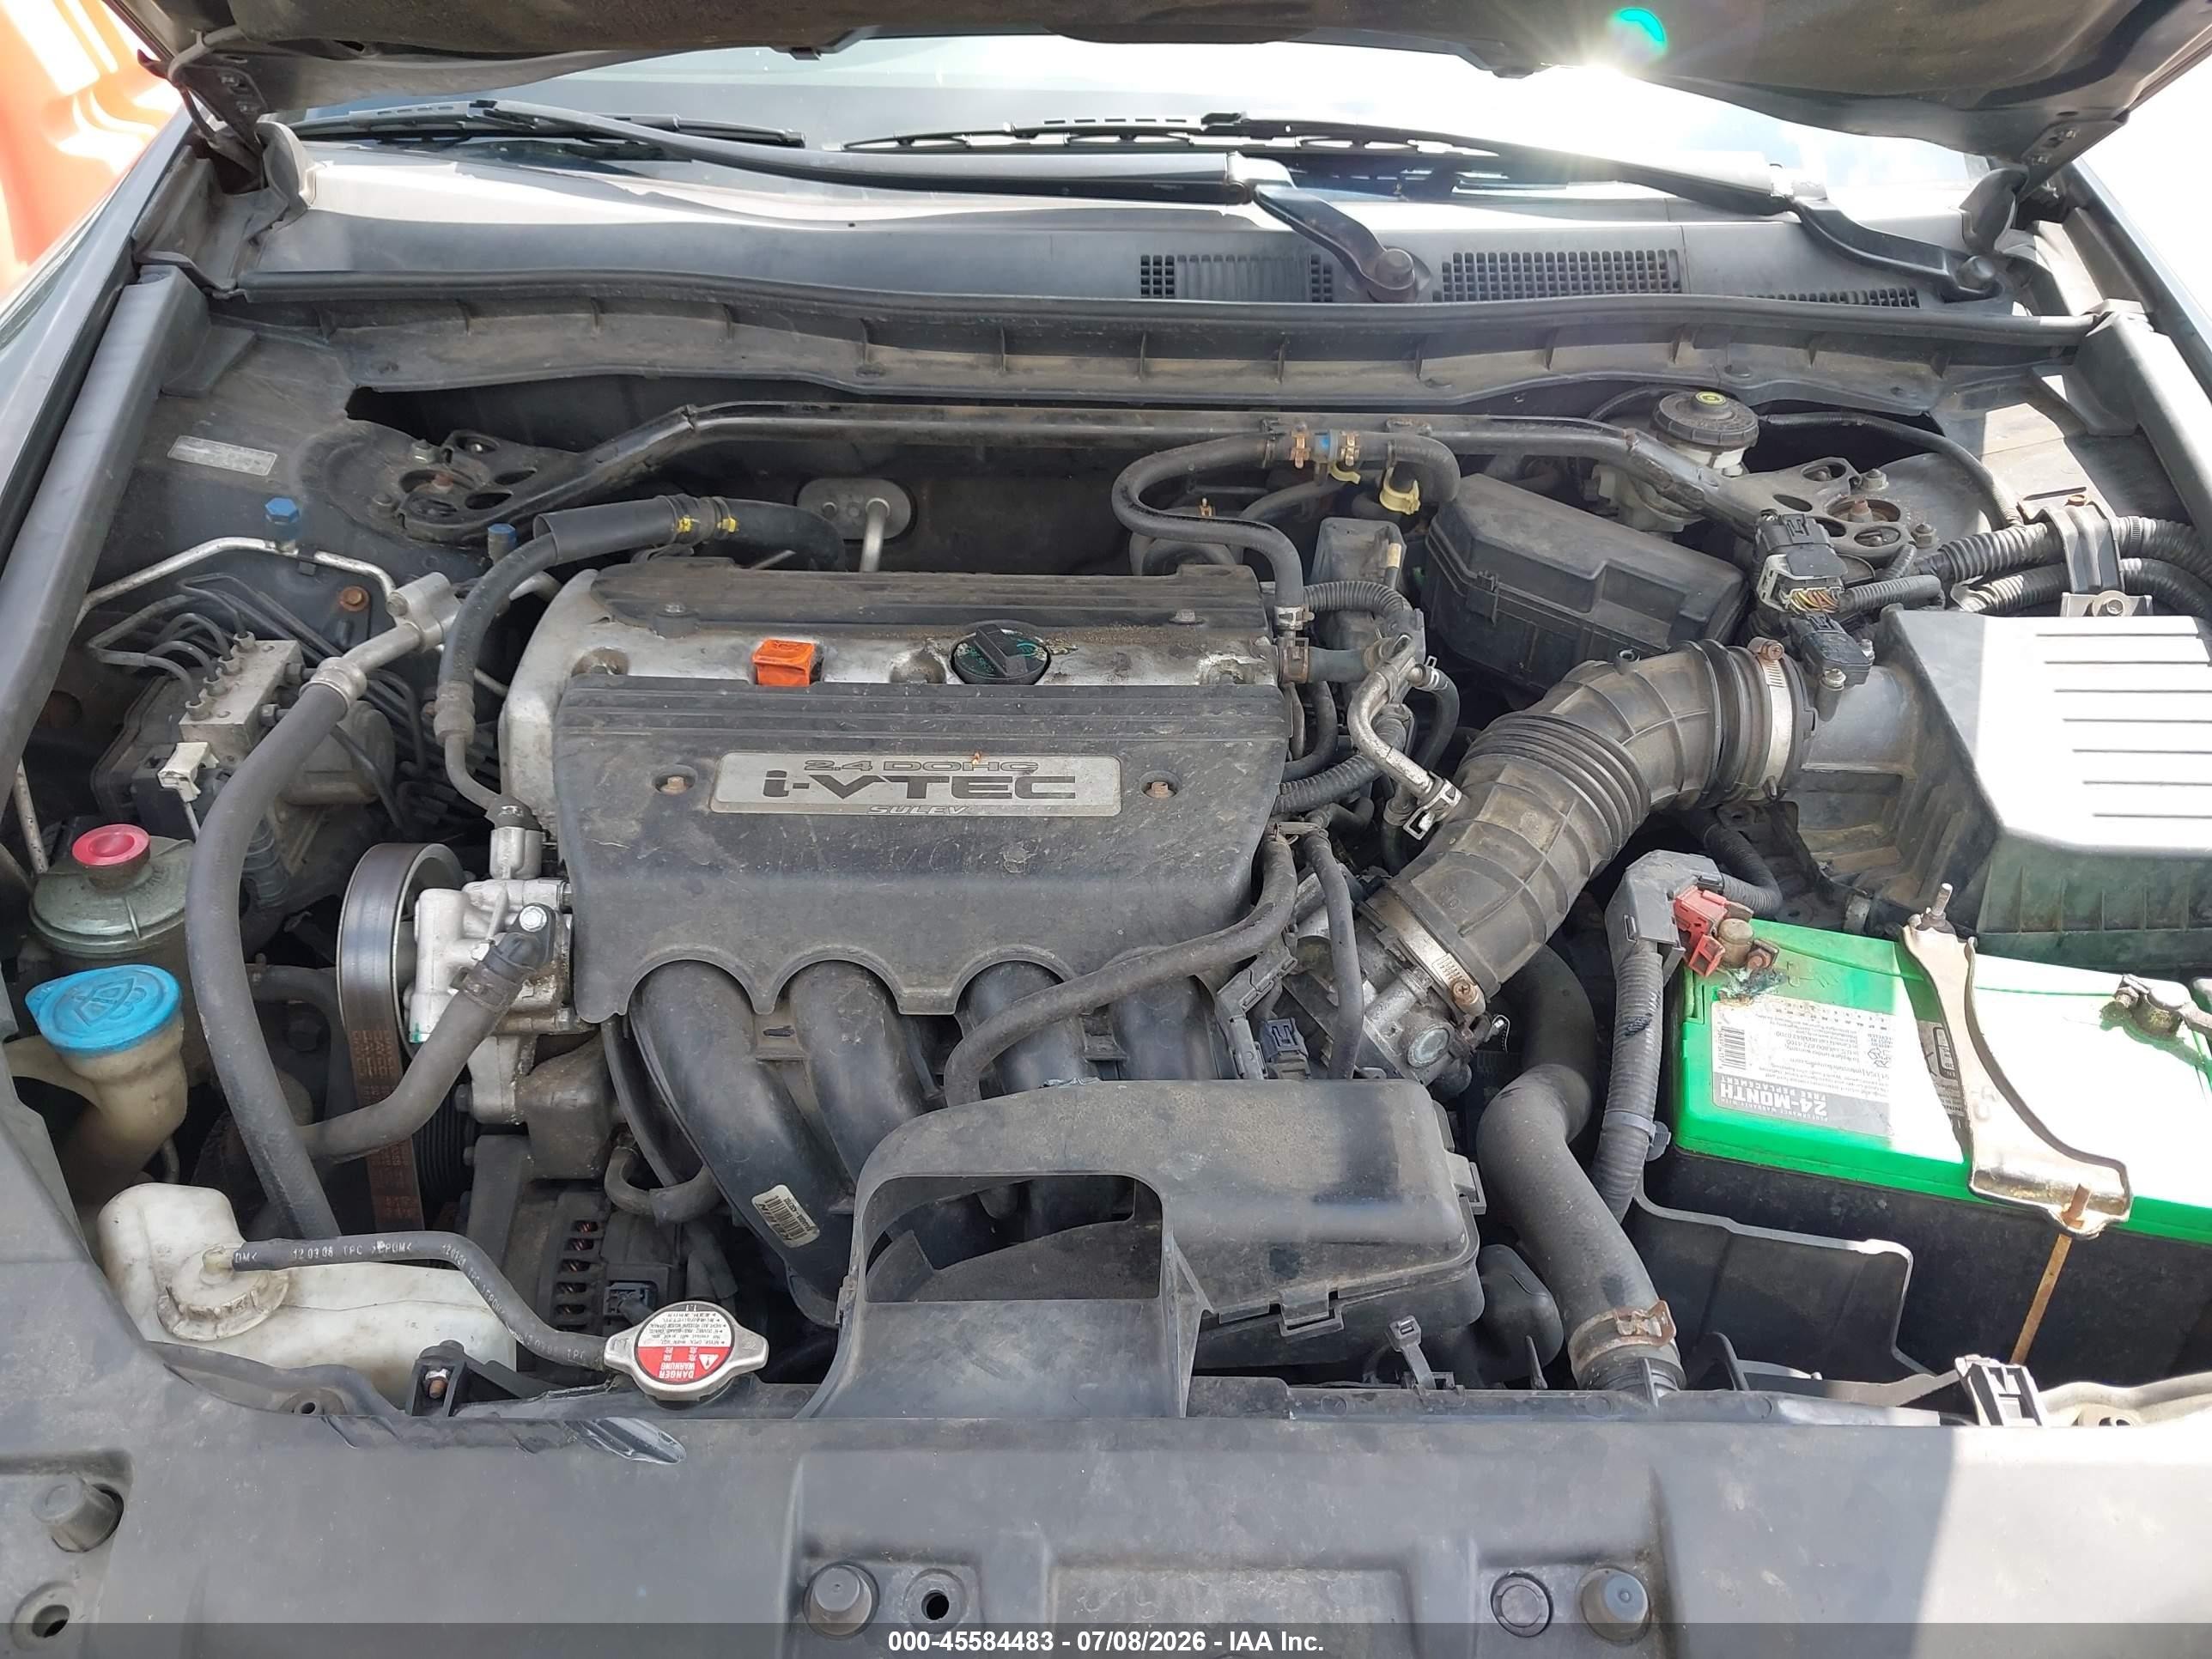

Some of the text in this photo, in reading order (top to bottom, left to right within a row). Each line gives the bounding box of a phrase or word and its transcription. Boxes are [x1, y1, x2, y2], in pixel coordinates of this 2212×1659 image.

[804, 759, 1039, 773] 2.4 DOHC
[763, 769, 1076, 799] i-VTEC
[1720, 1083, 1827, 1116] 24-MONTH
[1800, 1091, 1827, 1102] FREE
[659, 1362, 696, 1370] WARNUNG
[659, 1370, 695, 1379] DANGER
